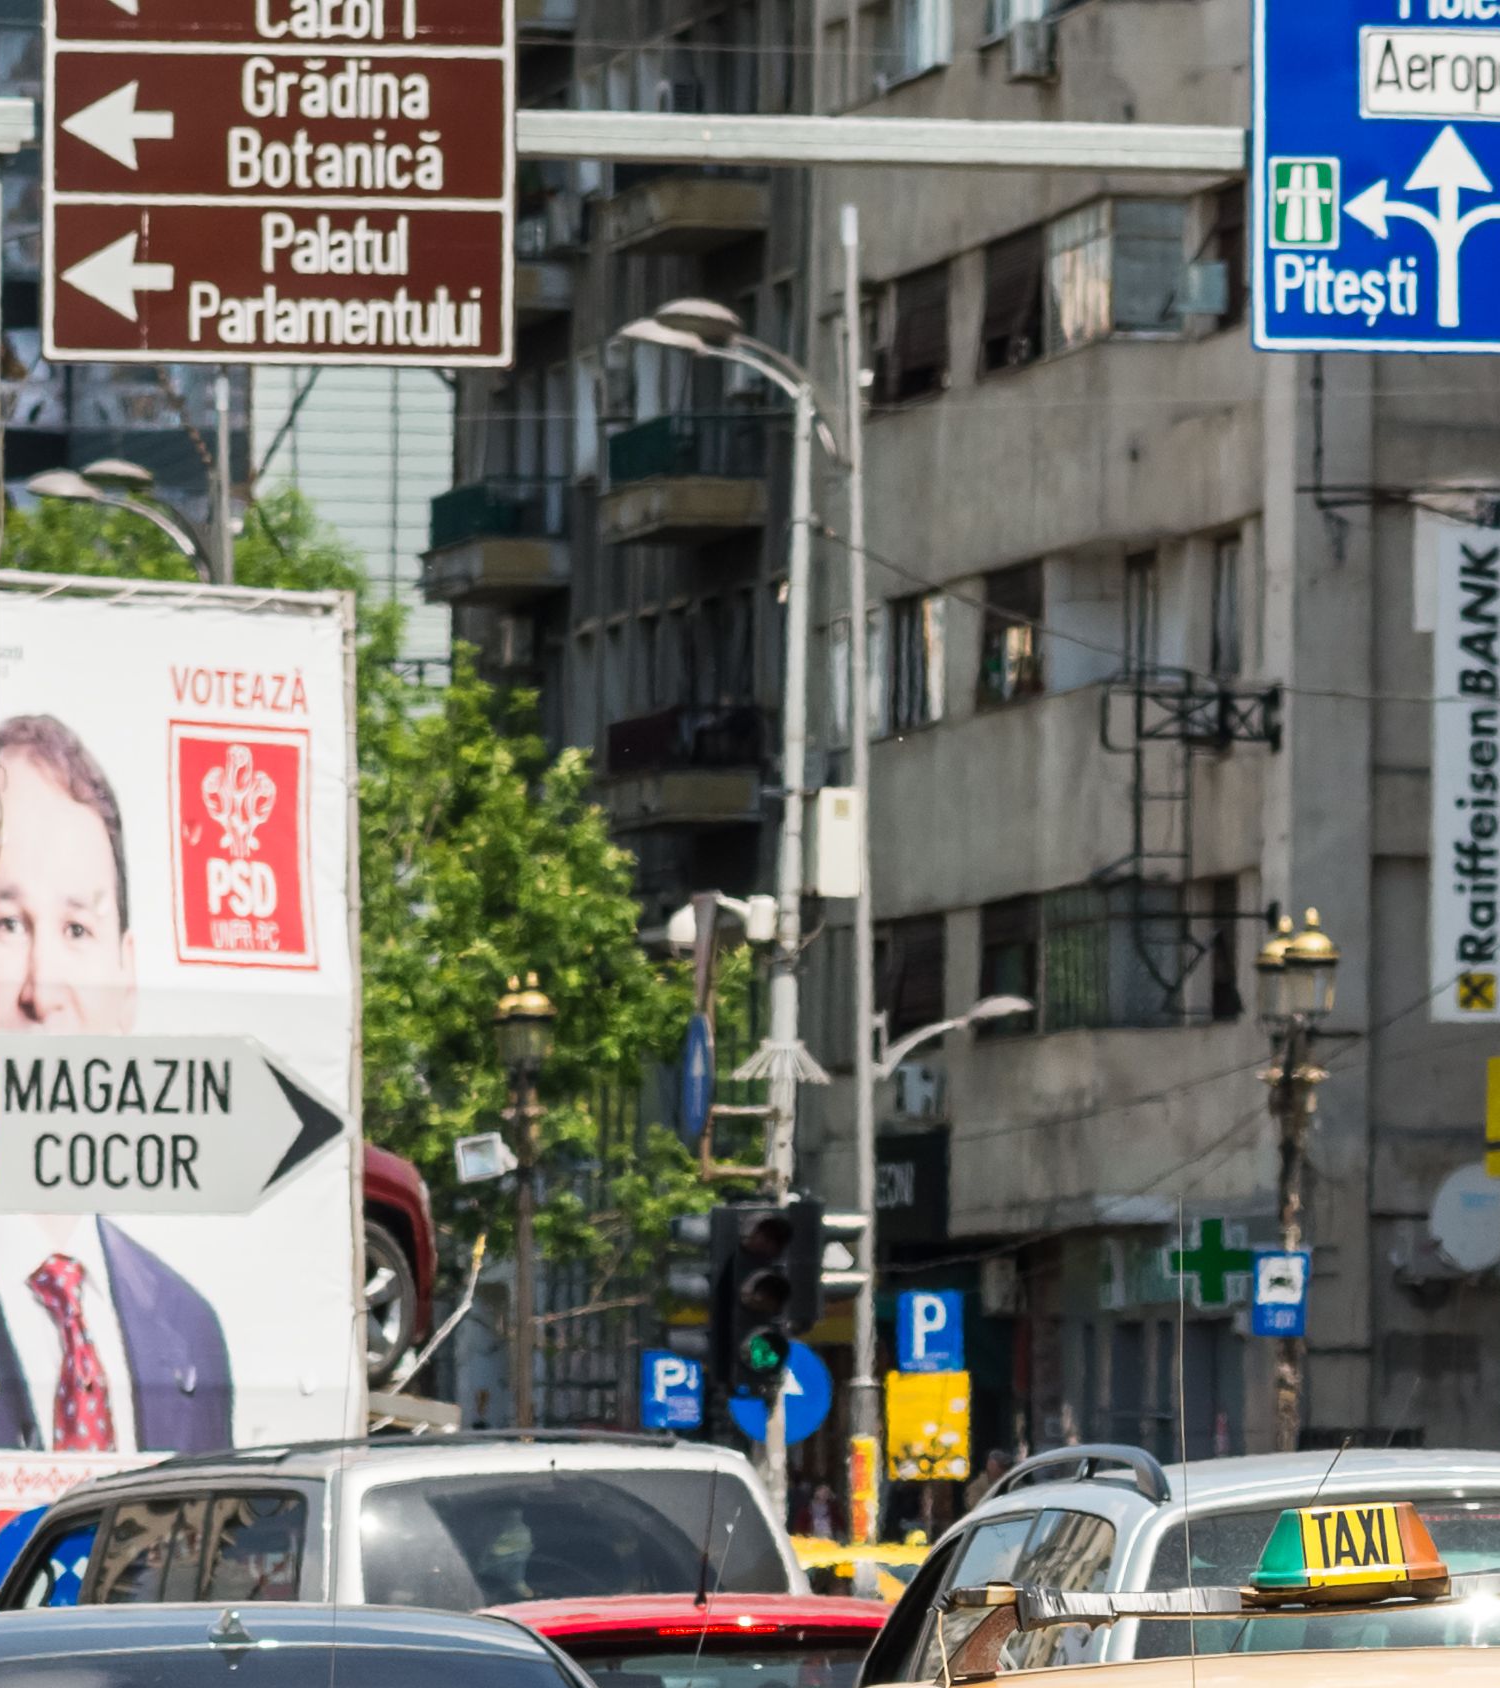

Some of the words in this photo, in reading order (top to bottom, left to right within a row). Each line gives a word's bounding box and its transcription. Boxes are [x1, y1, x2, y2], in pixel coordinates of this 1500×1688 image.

[242, 56, 430, 119] Grădina
[227, 127, 443, 190] Botanică
[261, 212, 408, 276] Palatul
[188, 281, 481, 347] Parlamentului
[1274, 255, 1418, 327] Pitești
[1458, 542, 1500, 700] BANK
[1453, 709, 1499, 966] Raiffeisen
[205, 857, 278, 918] PSD
[4, 1057, 233, 1117] MAGAZIN
[34, 1132, 202, 1192] COCOR
[912, 1295, 948, 1360] P
[1310, 1506, 1400, 1568] TAXI
